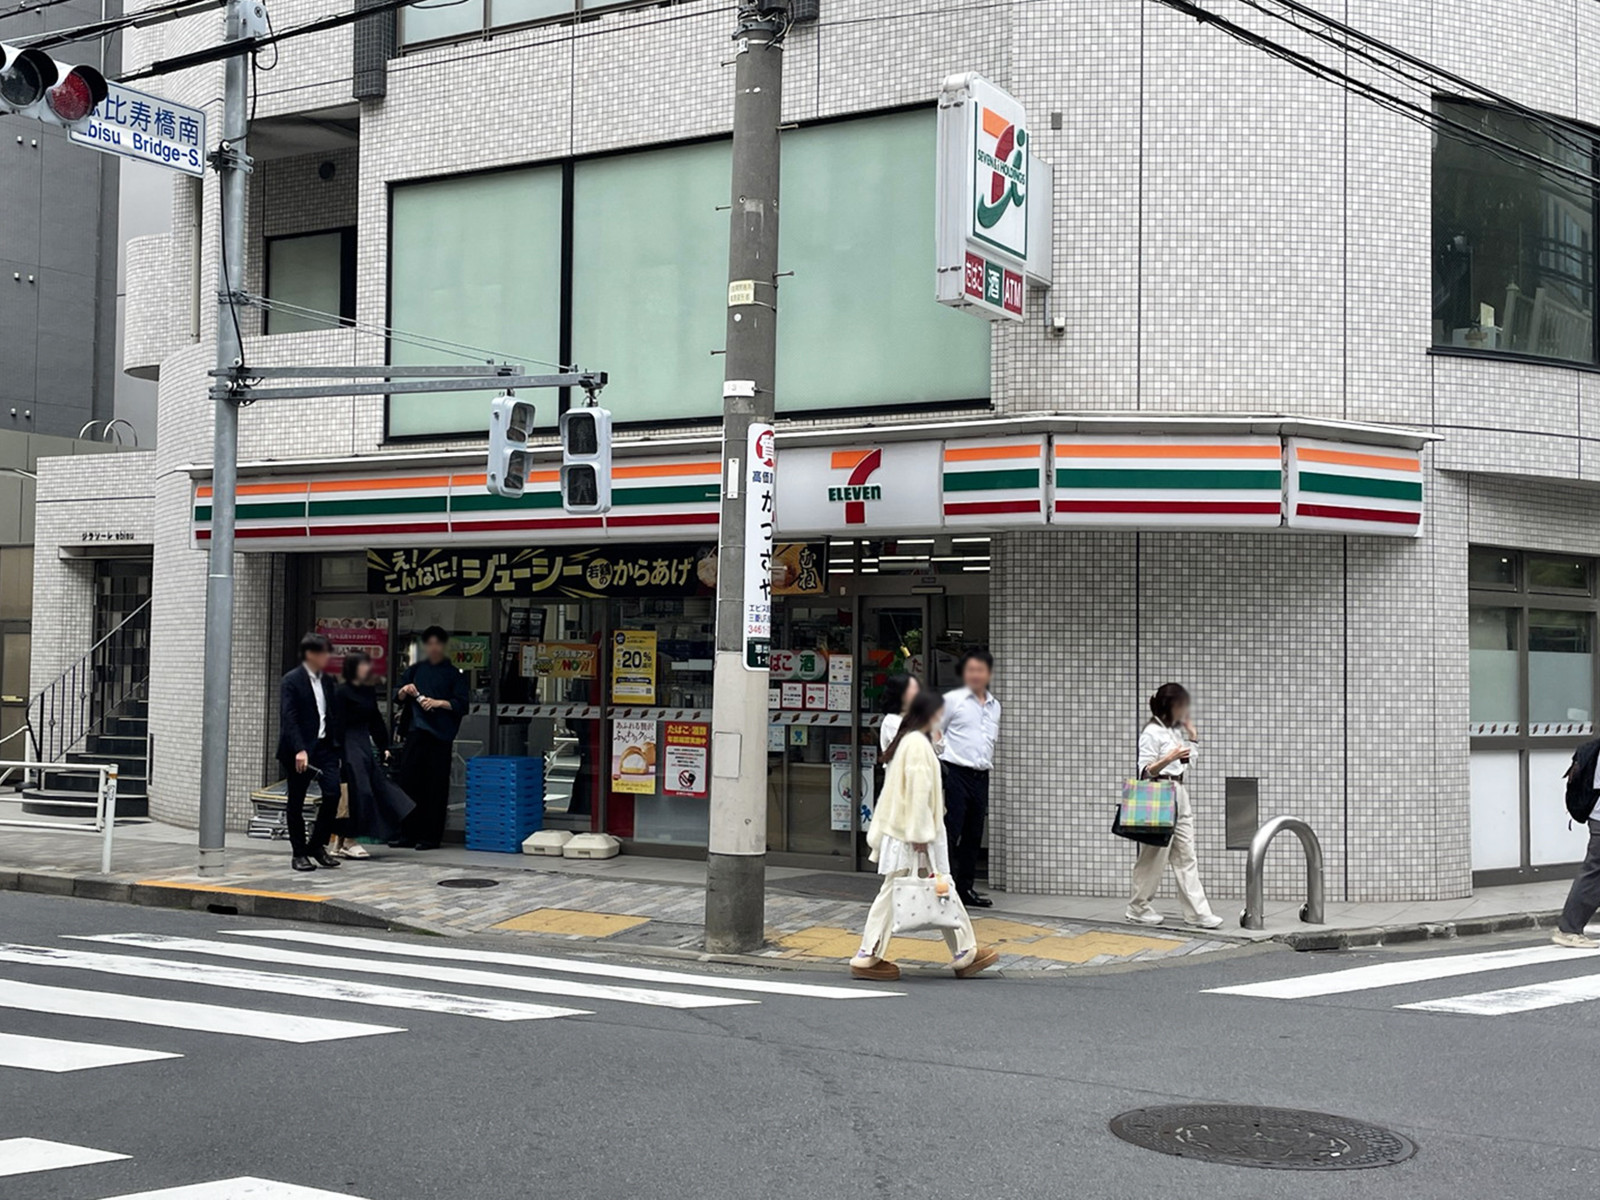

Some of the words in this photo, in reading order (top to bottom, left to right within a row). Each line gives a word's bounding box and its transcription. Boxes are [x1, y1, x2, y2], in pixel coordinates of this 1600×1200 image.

[92, 95, 199, 146] 比寿橋南
[79, 122, 121, 145] bisu
[133, 132, 201, 168] Bridge-S.
[966, 261, 983, 293] たばこ
[987, 269, 1000, 299] 酒
[1004, 277, 1021, 308] ATM
[612, 557, 694, 587] からあげ
[799, 548, 817, 590] むね
